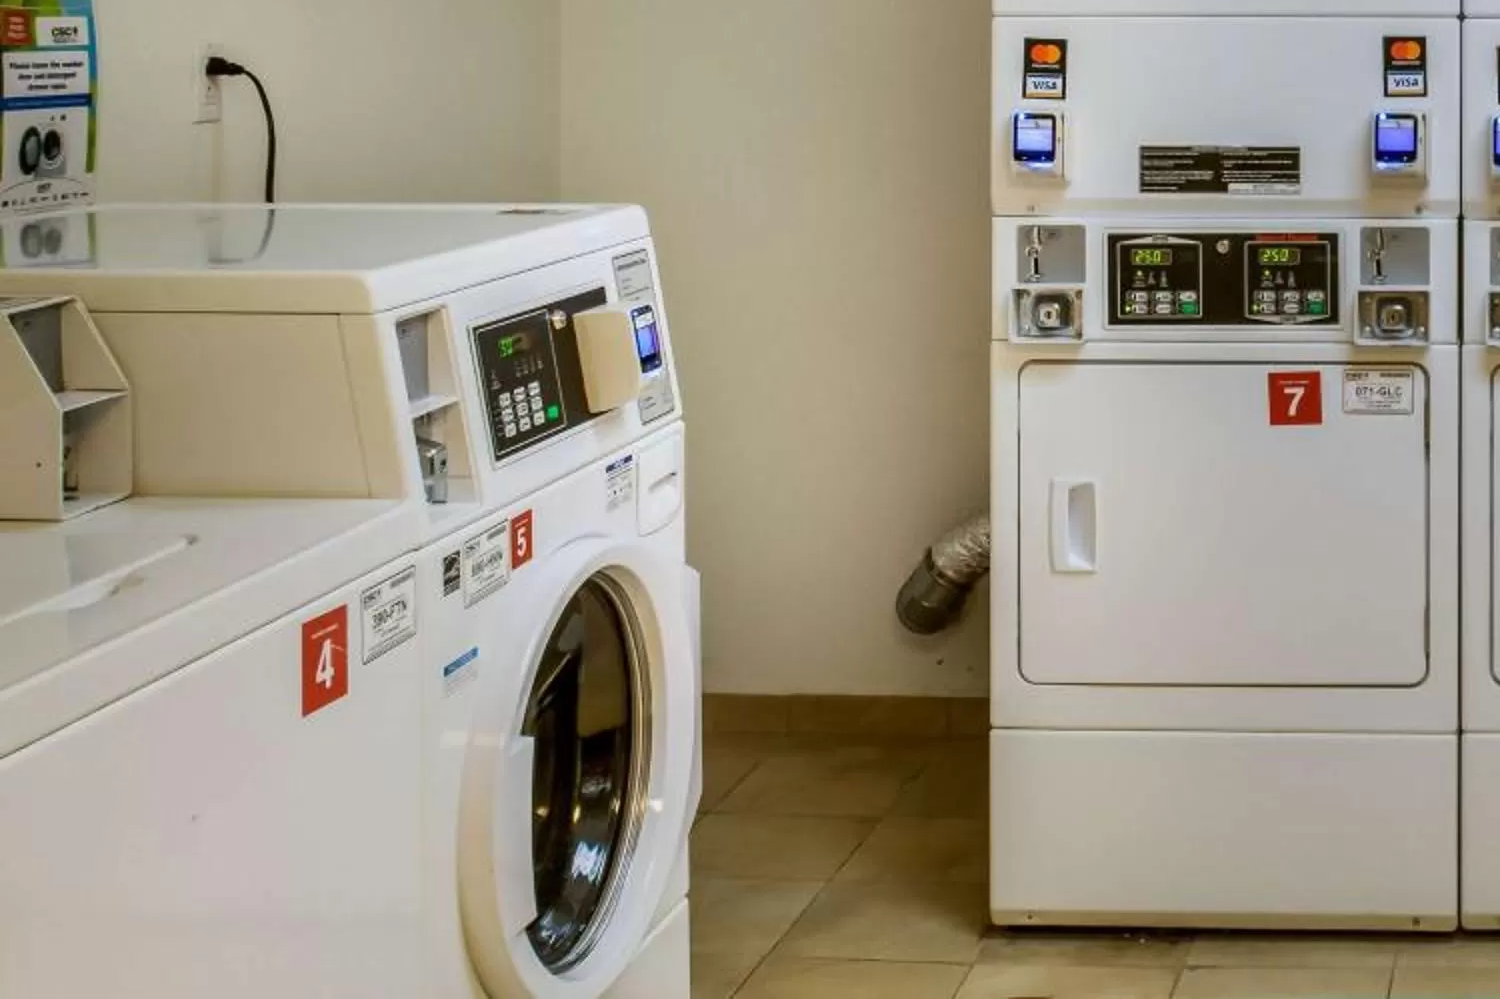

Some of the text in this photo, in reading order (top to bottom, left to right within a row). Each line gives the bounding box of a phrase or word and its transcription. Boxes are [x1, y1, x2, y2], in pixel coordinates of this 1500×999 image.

[1032, 80, 1057, 90] VISA
[1393, 77, 1419, 87] VISA
[1283, 386, 1305, 417] 7
[516, 527, 527, 557] 5
[315, 638, 335, 689] 4
